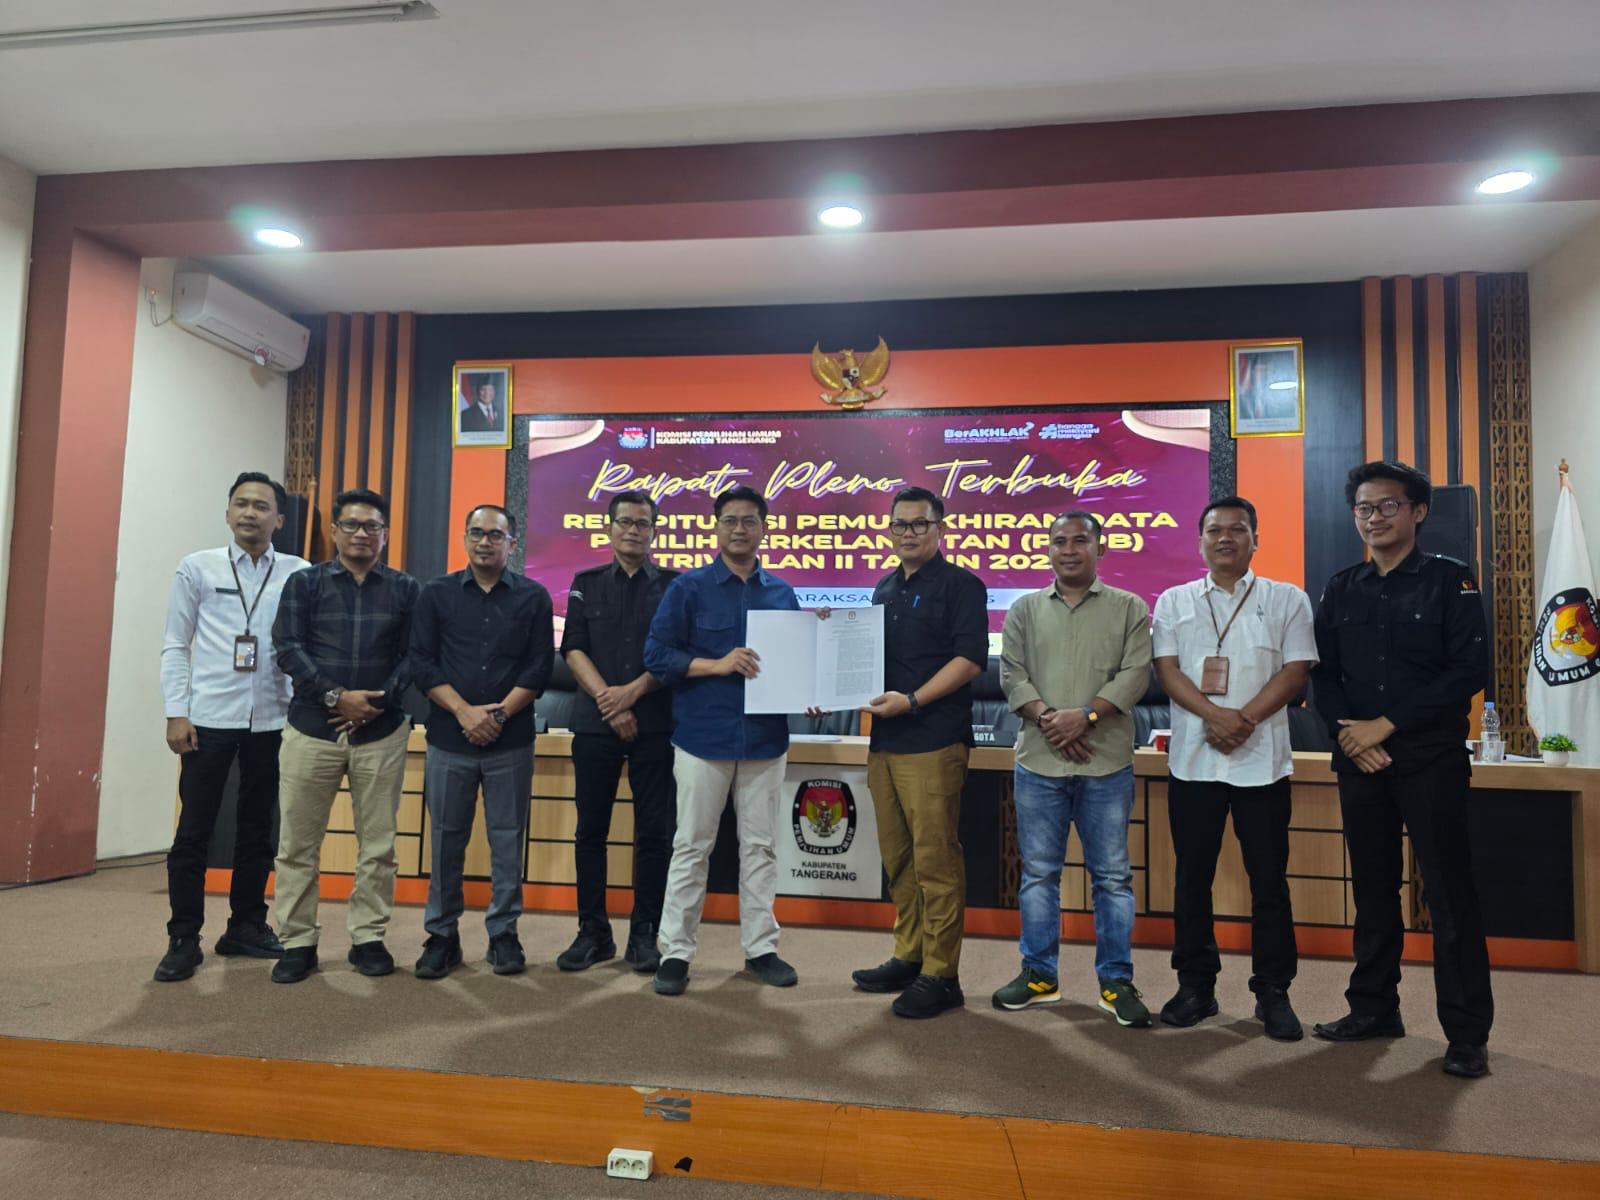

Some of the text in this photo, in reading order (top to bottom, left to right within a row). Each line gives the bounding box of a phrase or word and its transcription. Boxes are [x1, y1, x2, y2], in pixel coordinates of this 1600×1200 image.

[944, 425, 1032, 438] BerAKHLAK
[588, 454, 1146, 502] Rapat Pleno Terbuka
[563, 514, 786, 530] REPITUSI
[797, 513, 1058, 530] PEMUKHIRAN
[758, 533, 1010, 549] RKELANTAN
[1020, 532, 1144, 552] (PB)
[652, 553, 1053, 570] TRILAN II TAN 202
[807, 780, 842, 789] KOMISI
[793, 823, 854, 855] PEMILIHAN UMUM
[801, 861, 847, 870] KABUPATEN
[791, 868, 857, 881] TANGERANG
